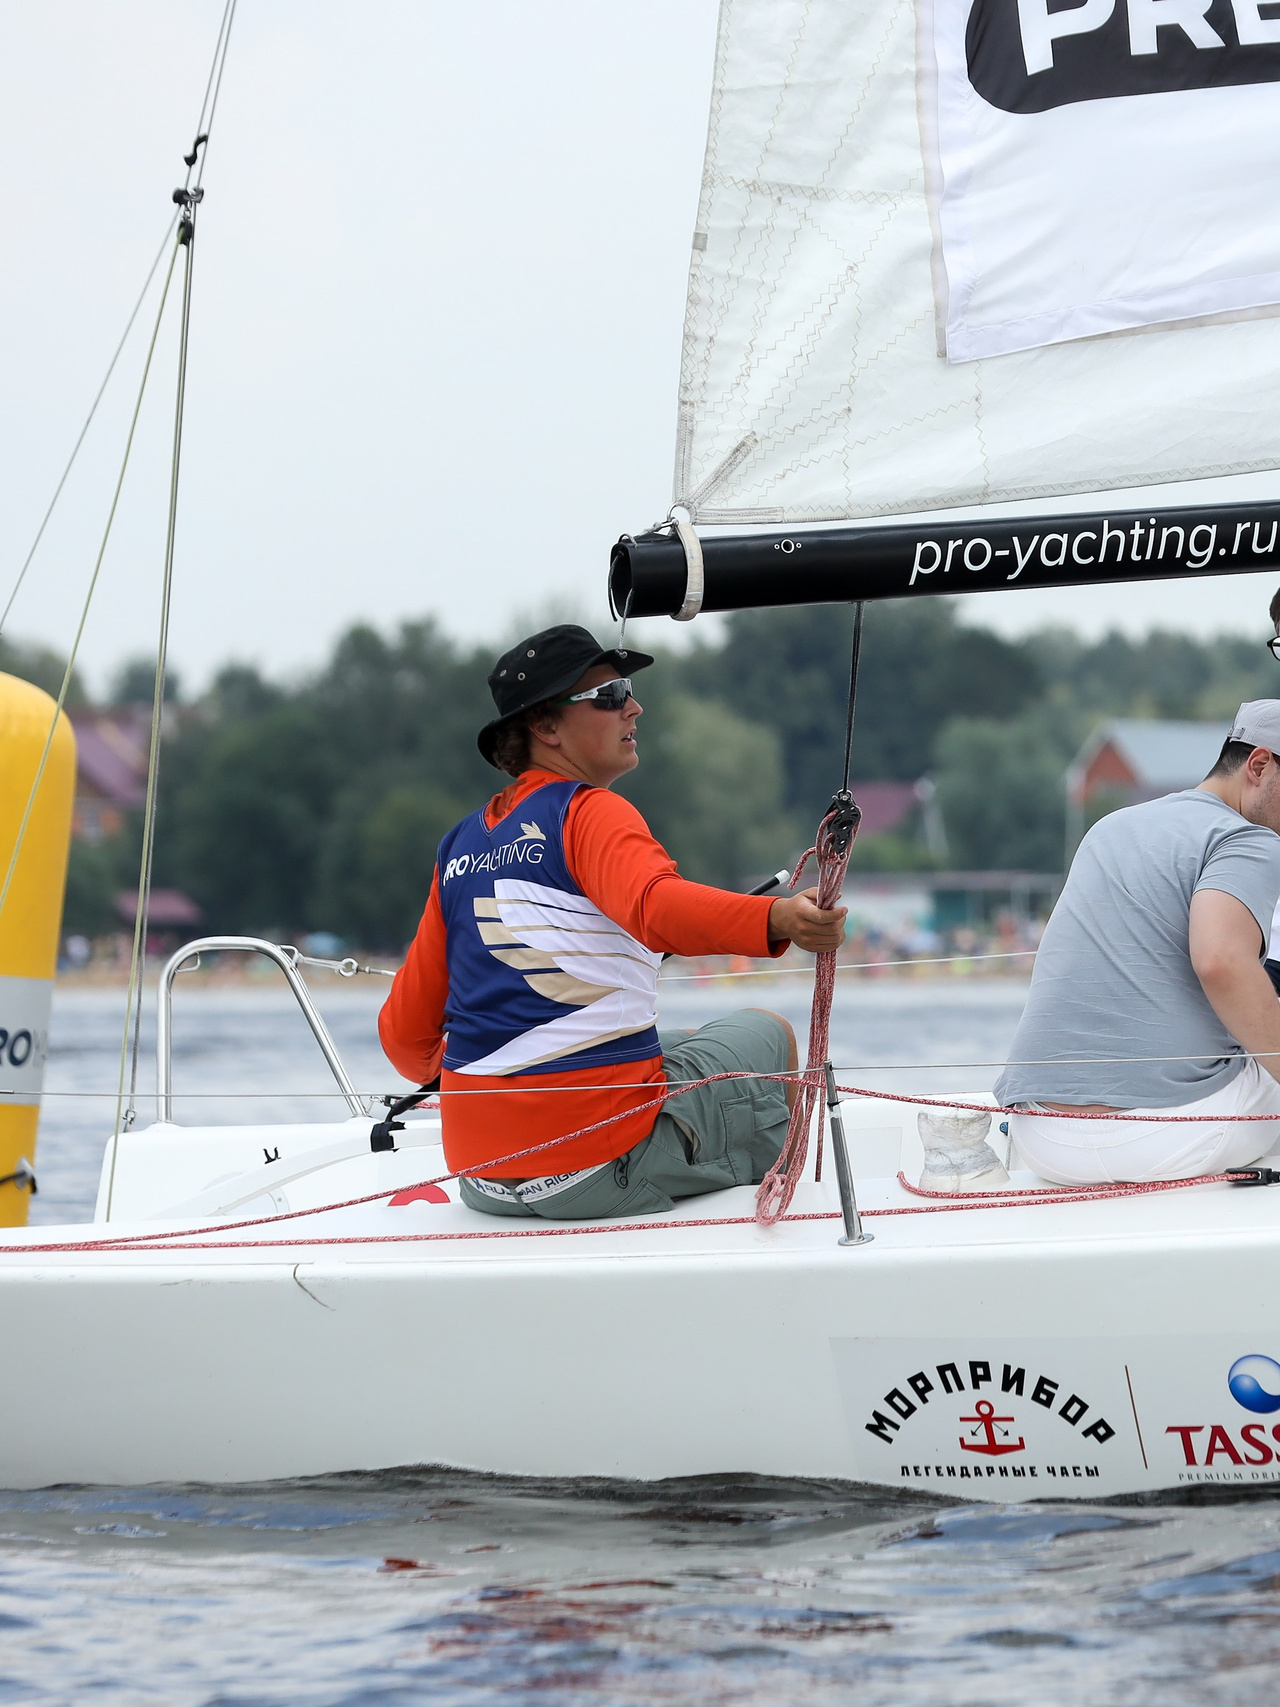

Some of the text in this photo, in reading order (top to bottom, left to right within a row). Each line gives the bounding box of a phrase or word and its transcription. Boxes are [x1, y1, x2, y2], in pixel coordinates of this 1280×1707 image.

[909, 518, 1279, 585] pro-yachting.ru
[865, 1360, 1116, 1445] МОРПРИБОР
[901, 1465, 1100, 1479] ЛЕГЕНДАРНЫЕ ЧАСЫ
[1178, 1472, 1244, 1482] PREMIUM
